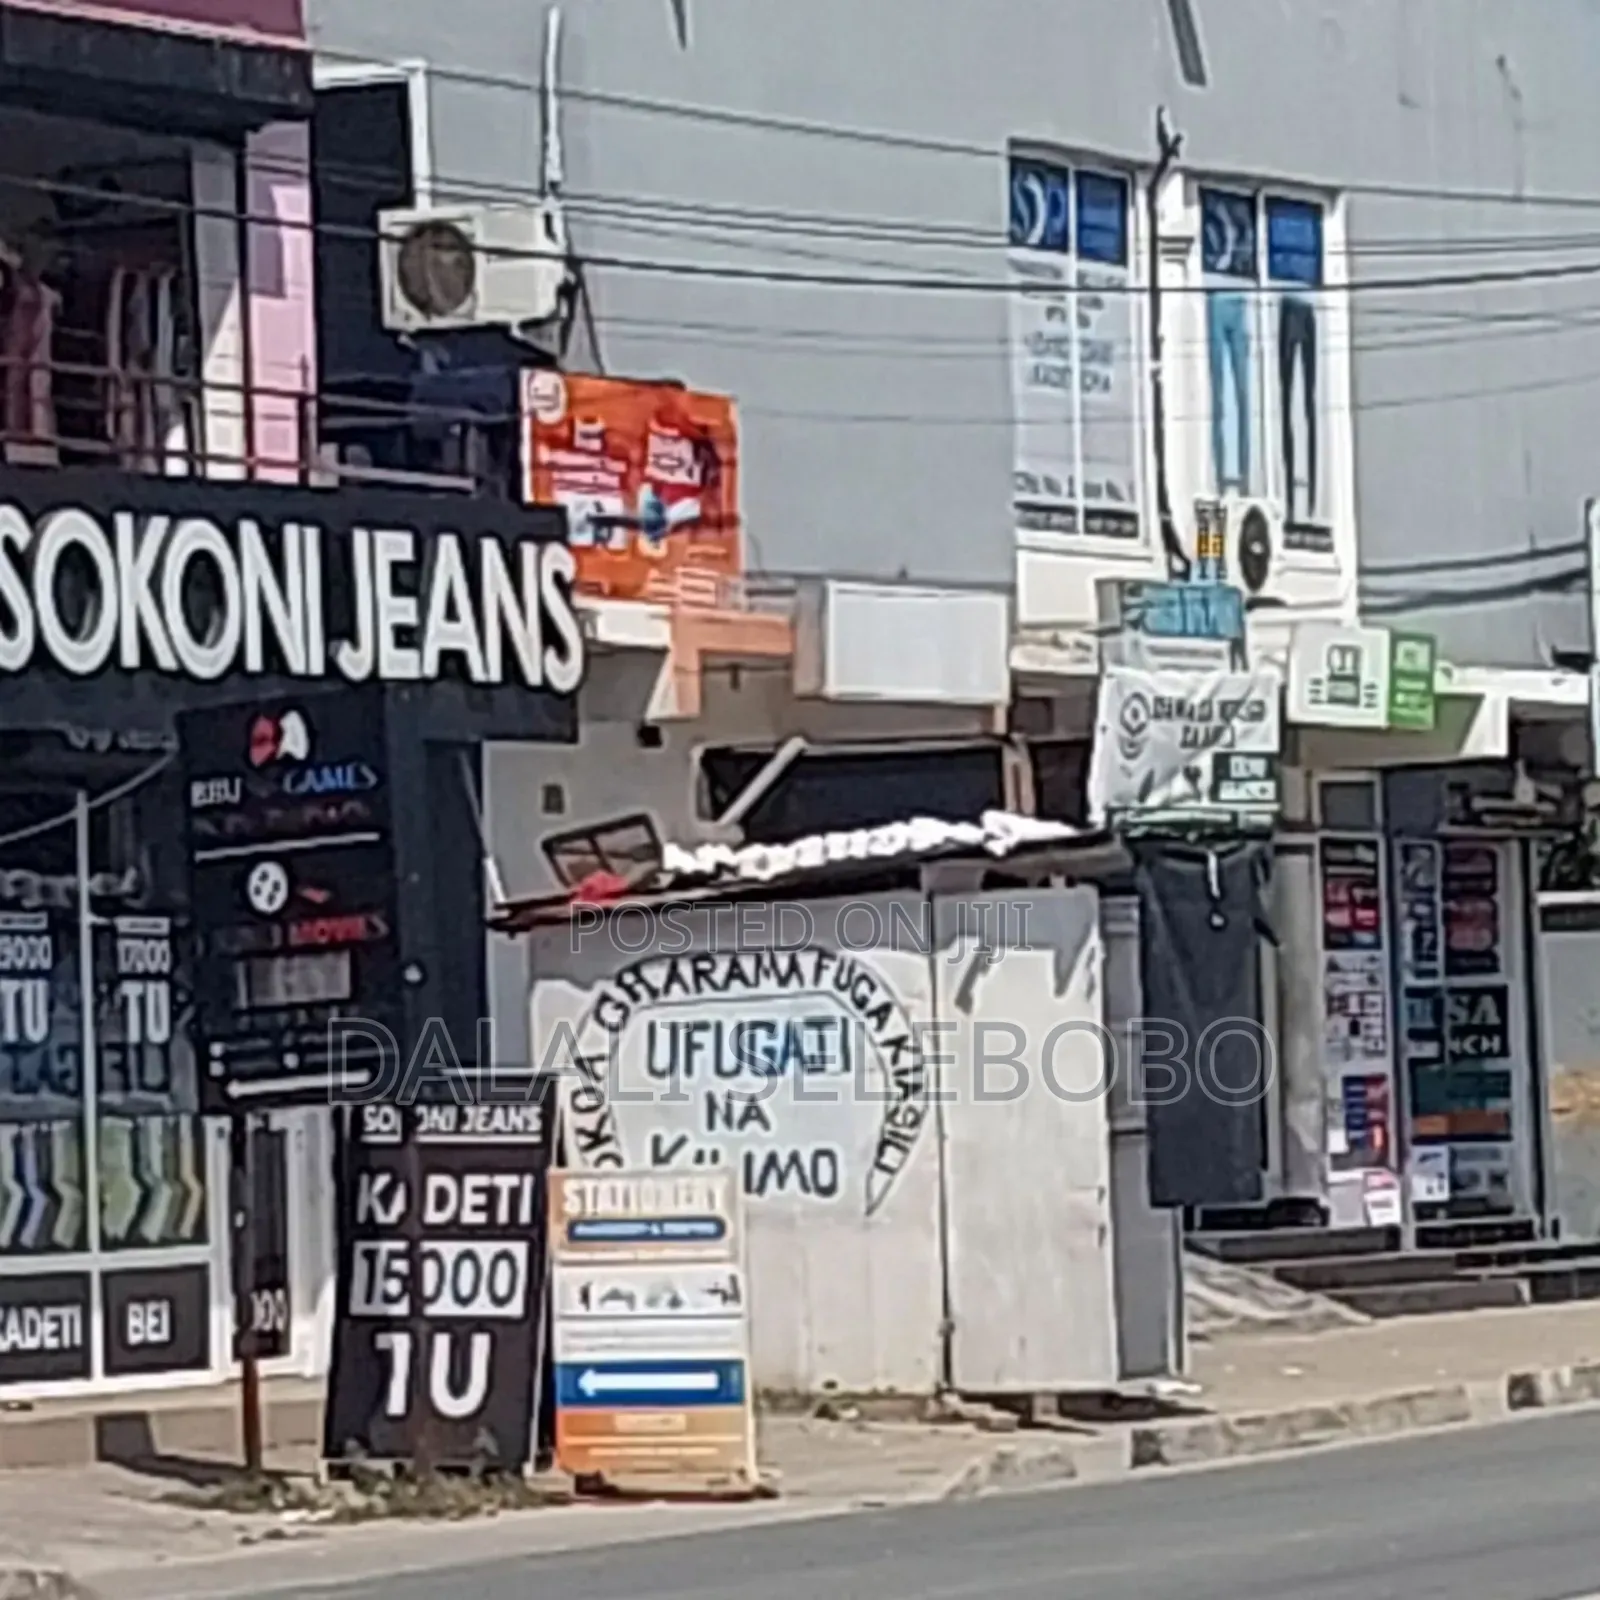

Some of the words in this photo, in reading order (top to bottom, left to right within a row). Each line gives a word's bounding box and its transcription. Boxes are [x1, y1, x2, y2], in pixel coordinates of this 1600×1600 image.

[335, 527, 584, 692] JEANS
[0, 978, 49, 1044] TU
[119, 980, 169, 1044] TU
[814, 950, 894, 1032] FUGA
[460, 1104, 542, 1132] JEANS
[705, 1089, 771, 1131] NA
[127, 1299, 170, 1346] BEI
